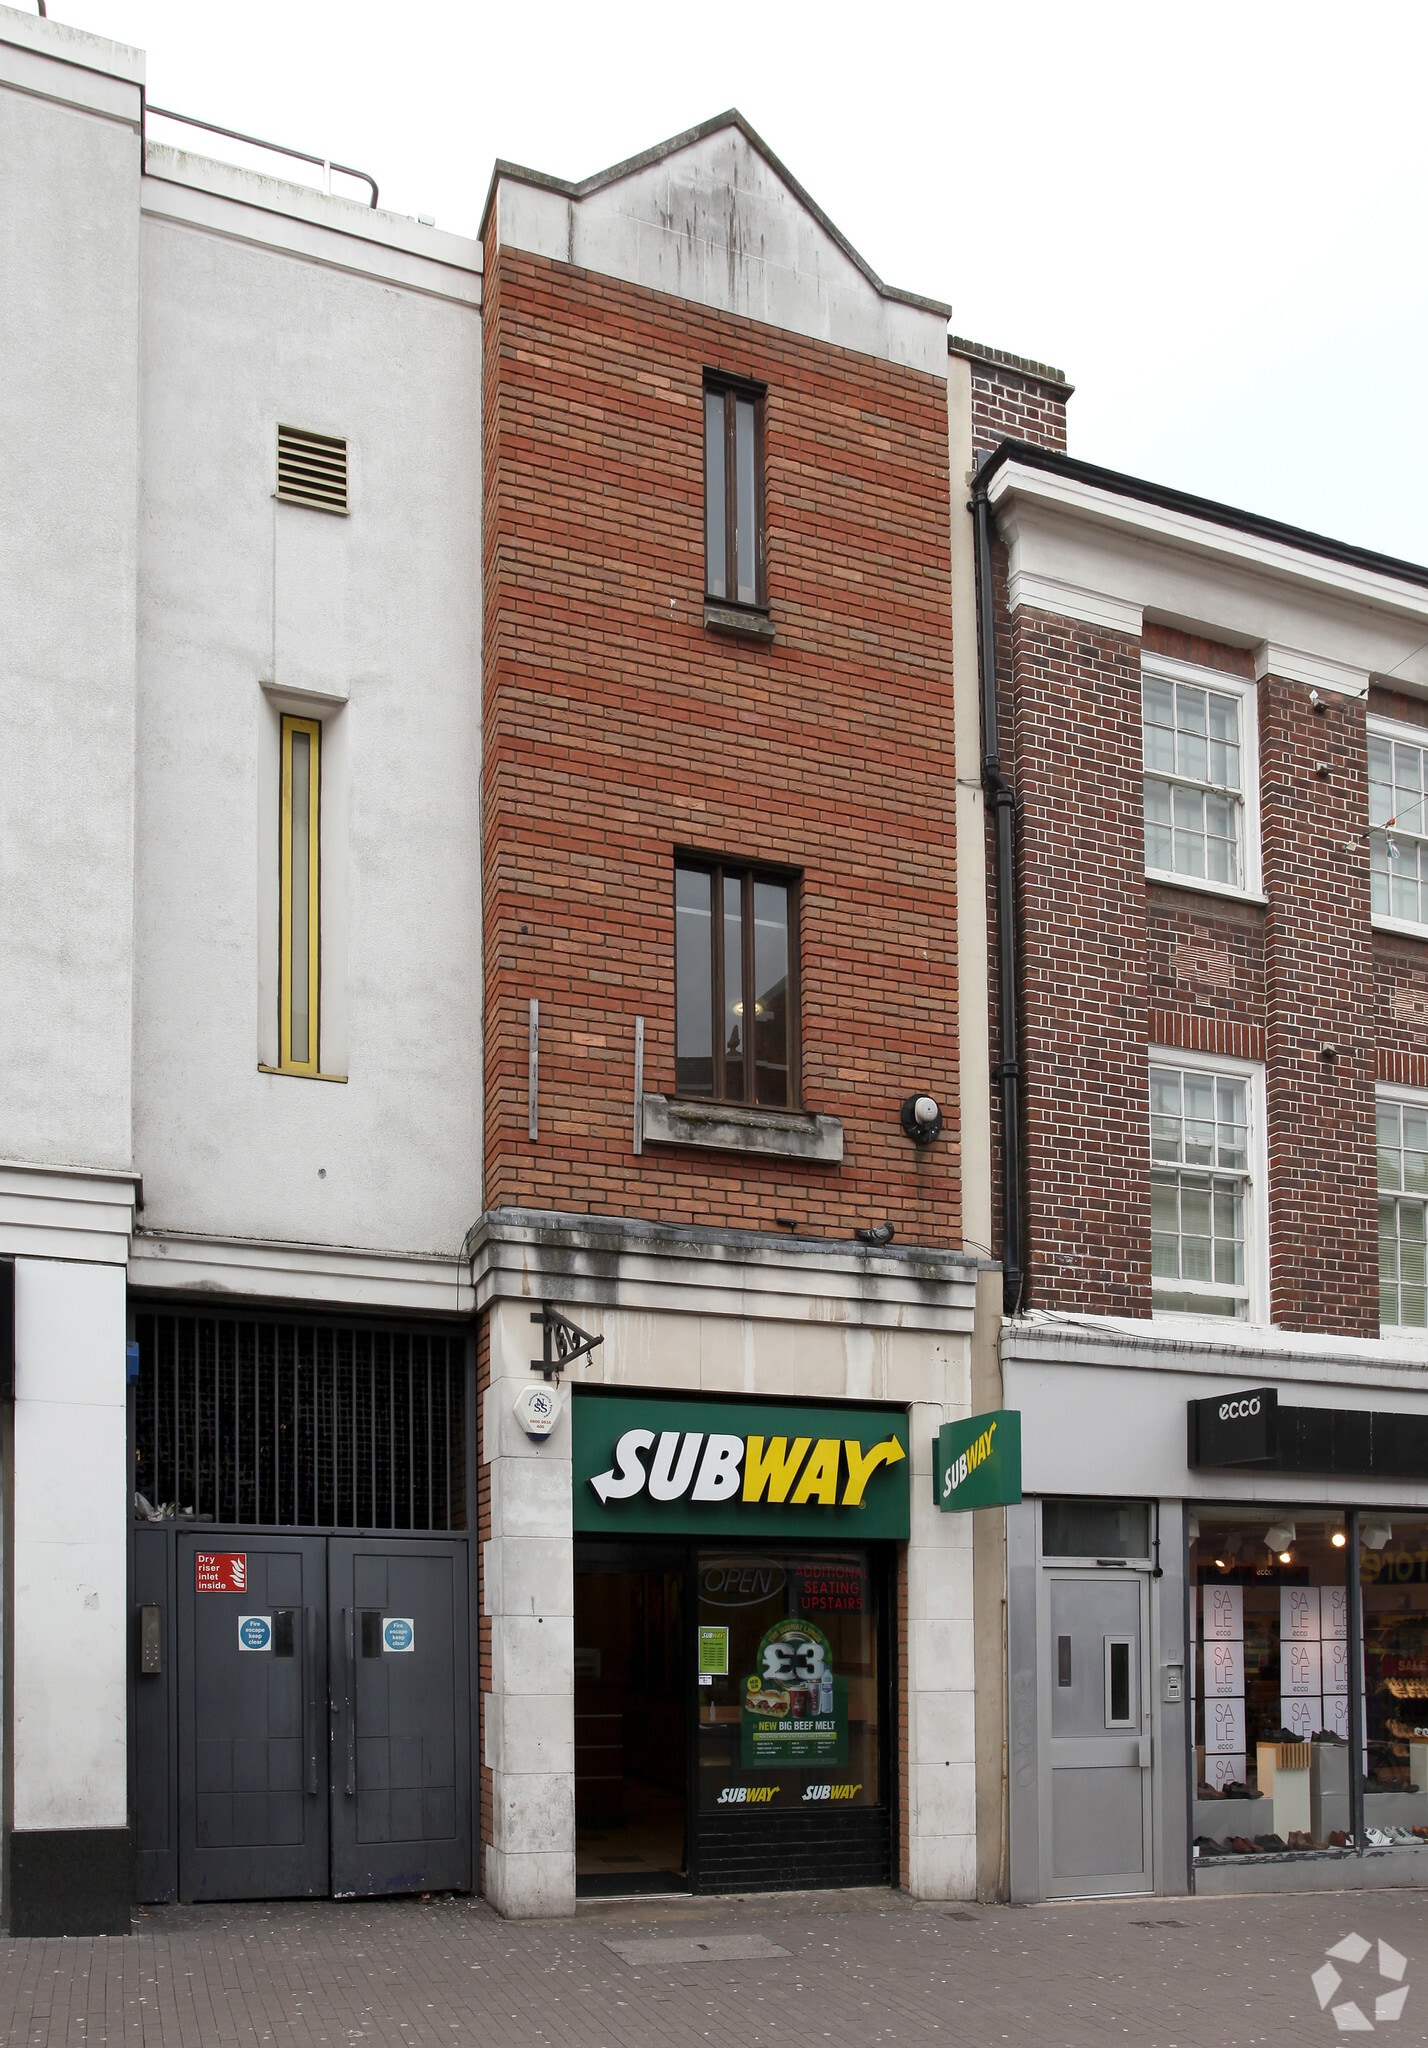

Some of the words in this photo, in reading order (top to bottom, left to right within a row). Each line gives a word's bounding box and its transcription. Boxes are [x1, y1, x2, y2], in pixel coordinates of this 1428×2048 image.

[1219, 1397, 1261, 1420] ecco
[590, 1428, 906, 1505] SUBWAY
[943, 1421, 997, 1498] SUBWAY
[198, 1555, 215, 1564] Dry
[198, 1564, 220, 1572] riser
[795, 1565, 868, 1580] ADDITIONAL
[198, 1573, 219, 1581] inlet
[704, 1567, 773, 1594] OPEN
[198, 1582, 227, 1590] inside
[805, 1581, 860, 1594] SEATING
[801, 1597, 863, 1610] UPSTAIRS
[762, 1643, 825, 1681] £3
[1398, 1660, 1427, 1671] SALE
[758, 1721, 777, 1731] NEW
[778, 1721, 792, 1731] BIG
[794, 1721, 814, 1731] BEEF
[815, 1720, 836, 1730] MELT
[717, 1786, 780, 1803] SUBWAY
[802, 1784, 863, 1800] SUBWAY
